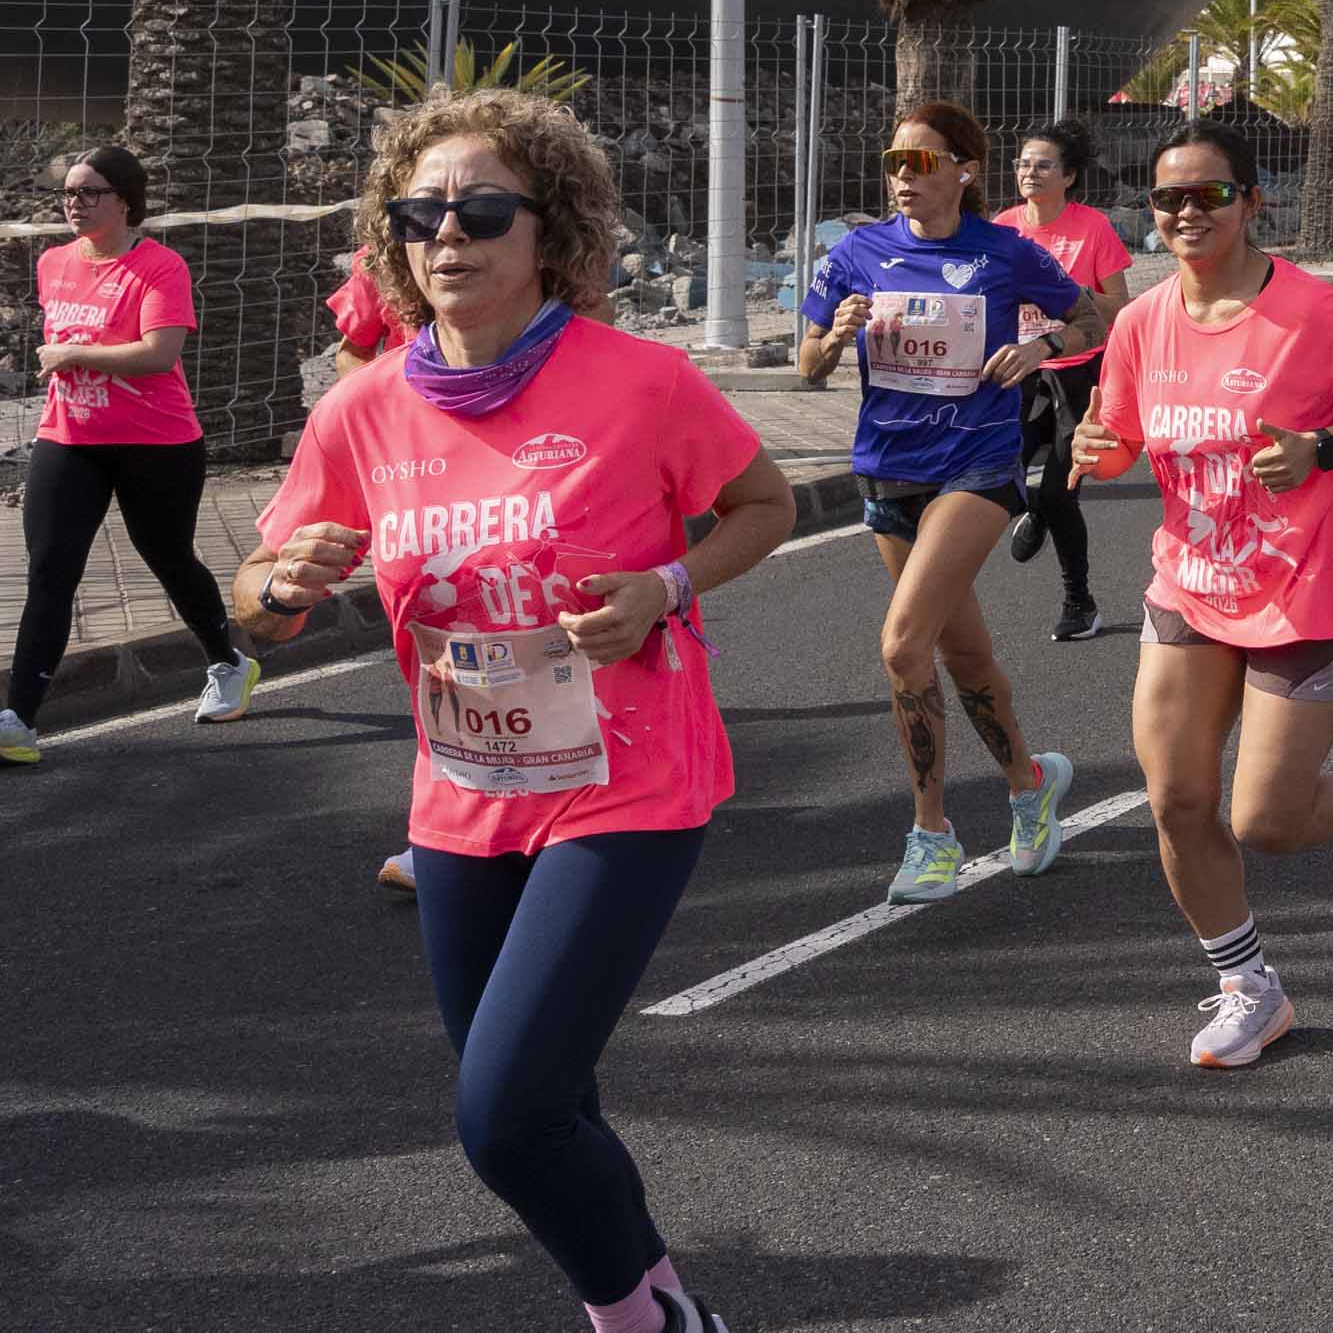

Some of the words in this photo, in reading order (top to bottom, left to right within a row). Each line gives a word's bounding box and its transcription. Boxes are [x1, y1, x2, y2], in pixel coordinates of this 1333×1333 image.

[903, 339, 947, 356] 016
[1150, 369, 1188, 384] OYSHO
[1149, 404, 1248, 442] CARRERA
[518, 445, 582, 464] ASTURIANA
[371, 458, 447, 484] OYSHO
[1207, 453, 1242, 497] DE
[379, 490, 560, 563] CARRERA
[1210, 522, 1234, 562] LA
[476, 563, 540, 627] DE
[465, 708, 532, 735] 016
[485, 741, 517, 753] 1472
[523, 754, 549, 765] GRAN
[551, 748, 595, 762] CANARIA
